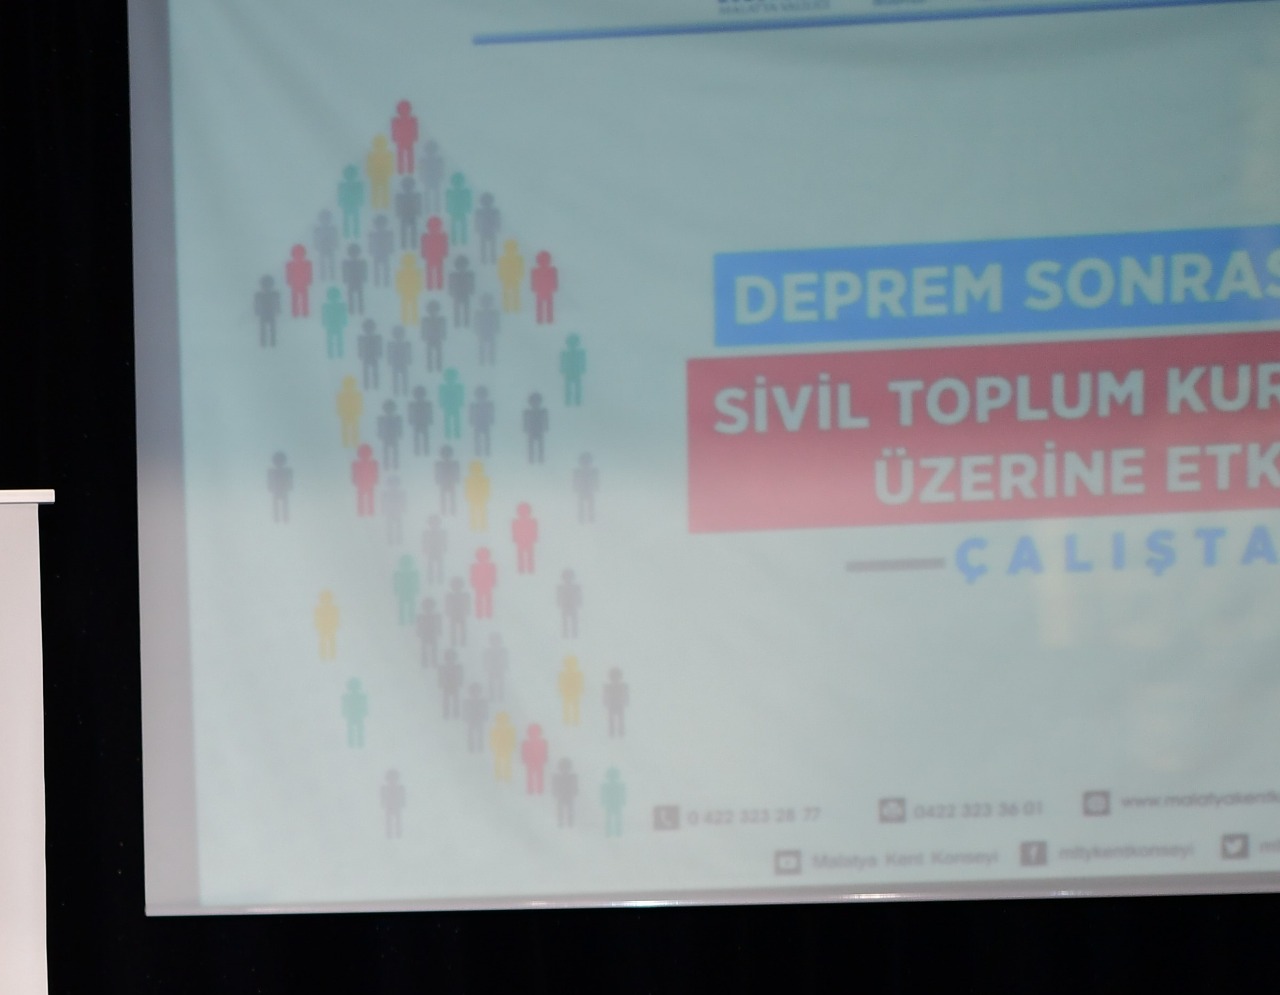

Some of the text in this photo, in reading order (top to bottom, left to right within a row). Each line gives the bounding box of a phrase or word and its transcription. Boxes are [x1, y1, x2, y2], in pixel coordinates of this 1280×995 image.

[734, 262, 1004, 325] DEPREM
[713, 372, 870, 435] SİVİL
[888, 368, 1144, 427] TOPLUM
[875, 441, 1147, 506] ÜZERİNE
